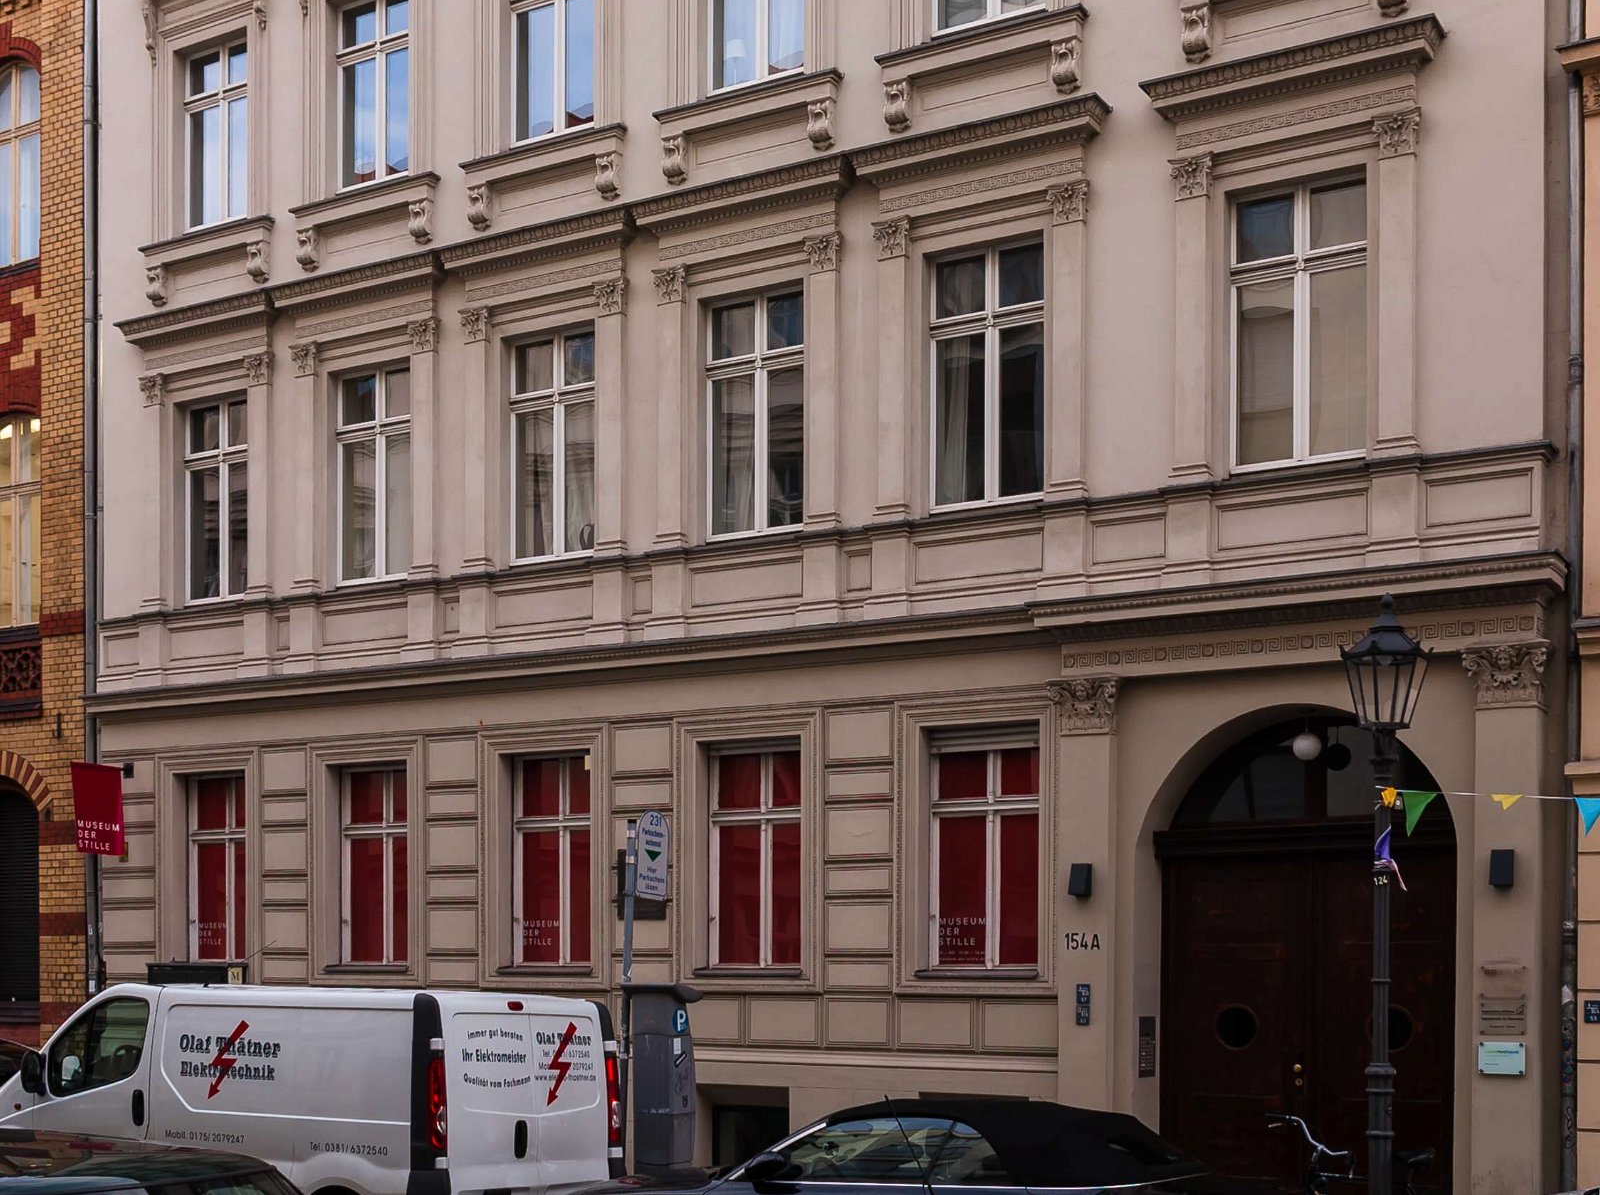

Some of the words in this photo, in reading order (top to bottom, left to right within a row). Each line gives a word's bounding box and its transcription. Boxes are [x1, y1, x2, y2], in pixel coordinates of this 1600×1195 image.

[77, 819, 120, 832] MUSEUM
[649, 814, 662, 827] 231
[78, 830, 97, 839] DER
[78, 840, 111, 851] STILLE
[646, 866, 658, 874] Hier
[639, 872, 665, 884] Parkschein
[523, 919, 560, 928] MUSEUM
[939, 917, 986, 926] MUSEUM
[523, 929, 540, 937] DER
[939, 927, 960, 936] DER
[199, 938, 221, 946] STILLE
[523, 938, 552, 946] STILLE
[939, 937, 976, 946] STILLE
[677, 1009, 687, 1032] P
[180, 1033, 212, 1054] Olaf
[536, 1031, 555, 1045] Olaf
[461, 1048, 473, 1062] Ihr
[475, 1048, 526, 1064] Elektromeister
[180, 1060, 276, 1081] Elektrtechnik
[463, 1072, 488, 1087] Qualität
[489, 1080, 502, 1088] vom
[165, 1129, 187, 1140] Mobil.
[212, 1132, 244, 1144] 2079247
[310, 1141, 323, 1152] Tel.
[350, 1144, 388, 1156] 6372540
